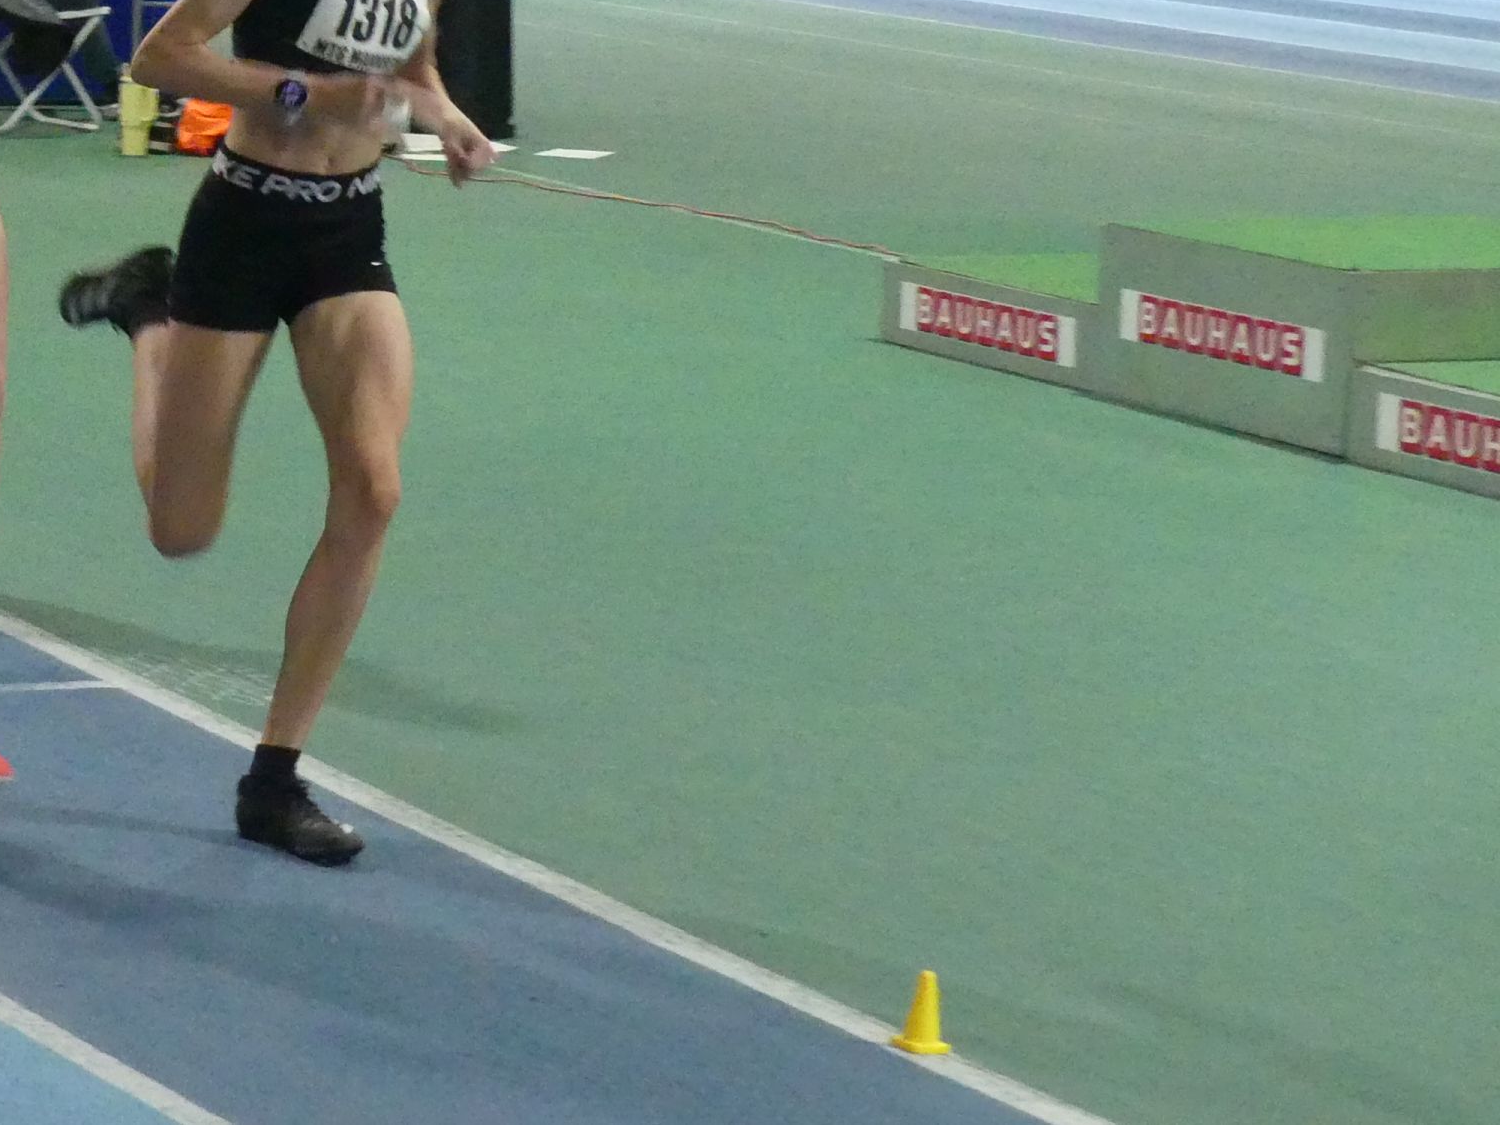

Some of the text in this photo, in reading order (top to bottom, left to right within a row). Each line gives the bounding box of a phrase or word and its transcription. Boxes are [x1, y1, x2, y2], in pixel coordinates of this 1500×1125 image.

[260, 173, 343, 203] PRO
[916, 292, 1057, 353] BAUHAUS
[1140, 301, 1302, 367] BAUHAUS
